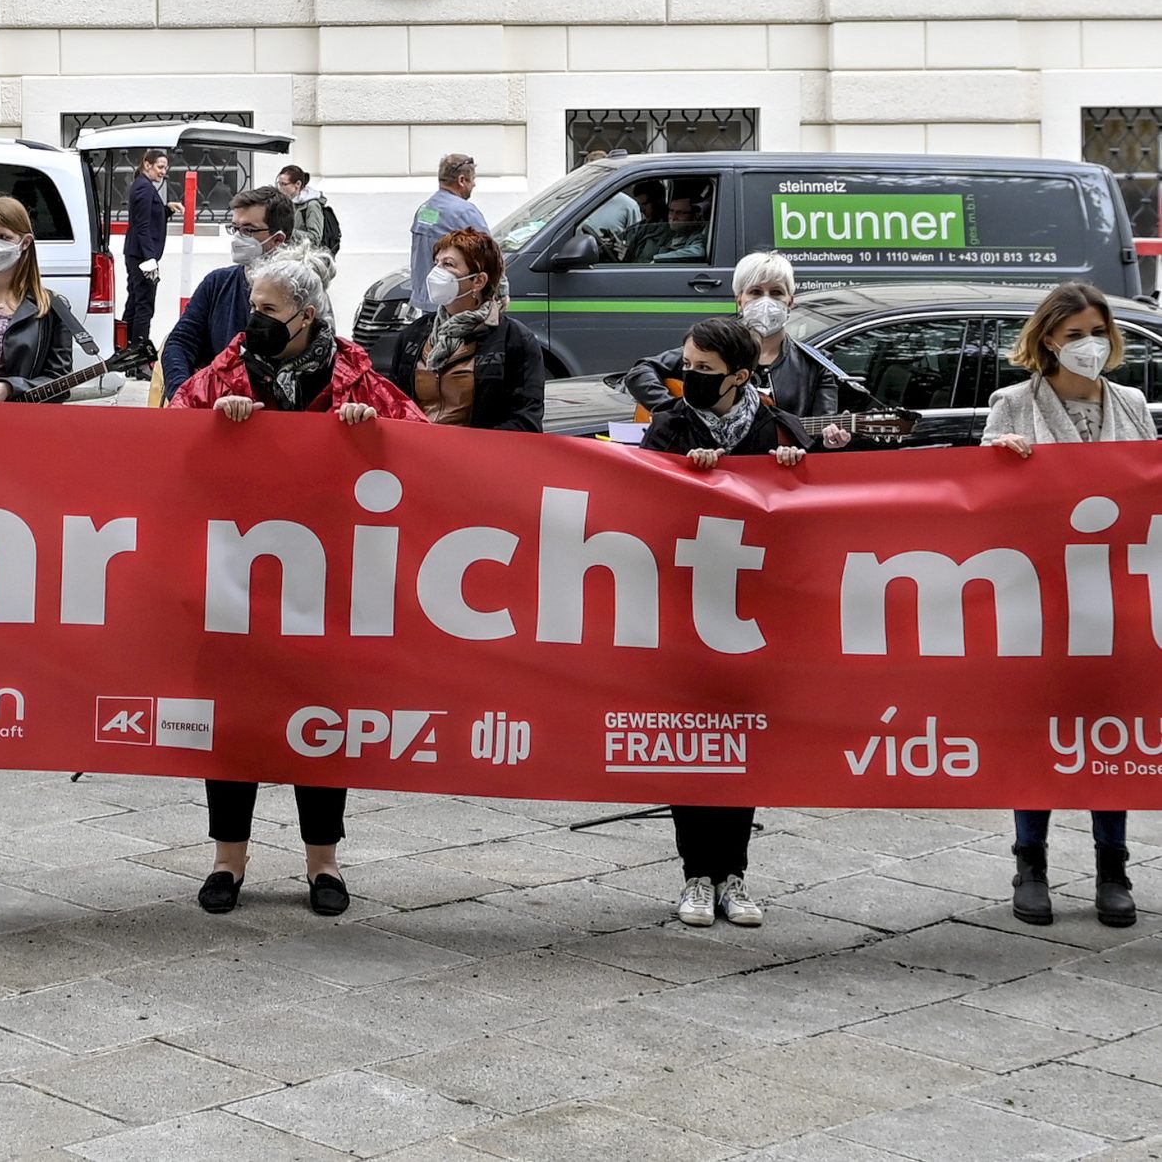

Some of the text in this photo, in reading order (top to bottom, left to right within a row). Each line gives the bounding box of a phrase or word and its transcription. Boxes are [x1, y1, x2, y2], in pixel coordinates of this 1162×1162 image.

[778, 180, 847, 193] steinmetz
[780, 202, 956, 240] brunner
[858, 252, 872, 262] 10
[886, 252, 909, 262] 1110
[910, 252, 934, 262] wien
[958, 252, 978, 262] +43
[1003, 252, 1023, 262] 813
[204, 469, 767, 654] nicht
[102, 710, 209, 735] AK ÖSTERREICH
[286, 705, 531, 765] GPA djp
[605, 712, 768, 730] GEWERKSCHAFTS
[605, 732, 747, 763] FRAUEN
[843, 706, 979, 777] vida
[1092, 760, 1119, 775] Die
